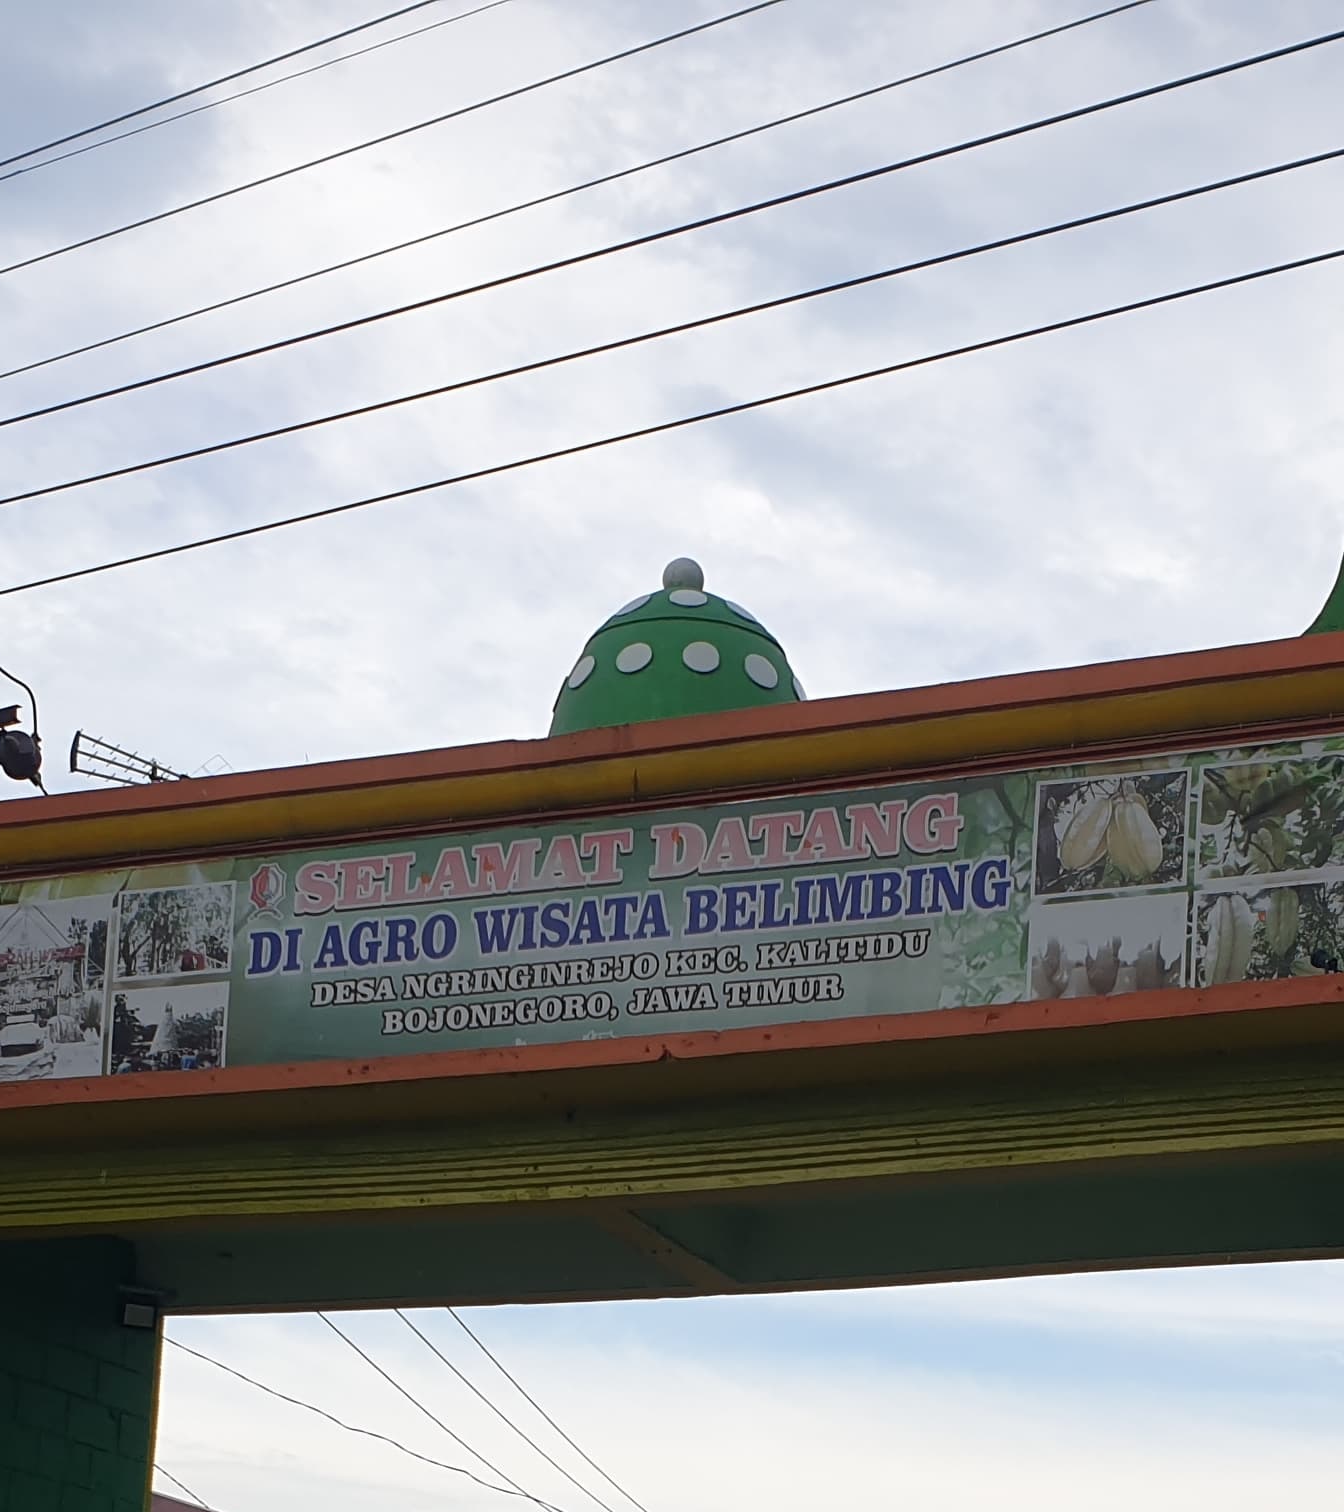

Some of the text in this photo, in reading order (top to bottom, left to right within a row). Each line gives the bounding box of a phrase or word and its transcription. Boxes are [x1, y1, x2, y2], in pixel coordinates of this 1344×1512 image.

[294, 793, 963, 917] SELAMAT DATANG
[247, 858, 1012, 976] DI AGRO WISATA BELIMBING
[311, 929, 930, 1007] DESA NGRINGINREJO KEC. KALITIDU
[382, 974, 844, 1035] BOJONEGORO, JAWA TIMUR
